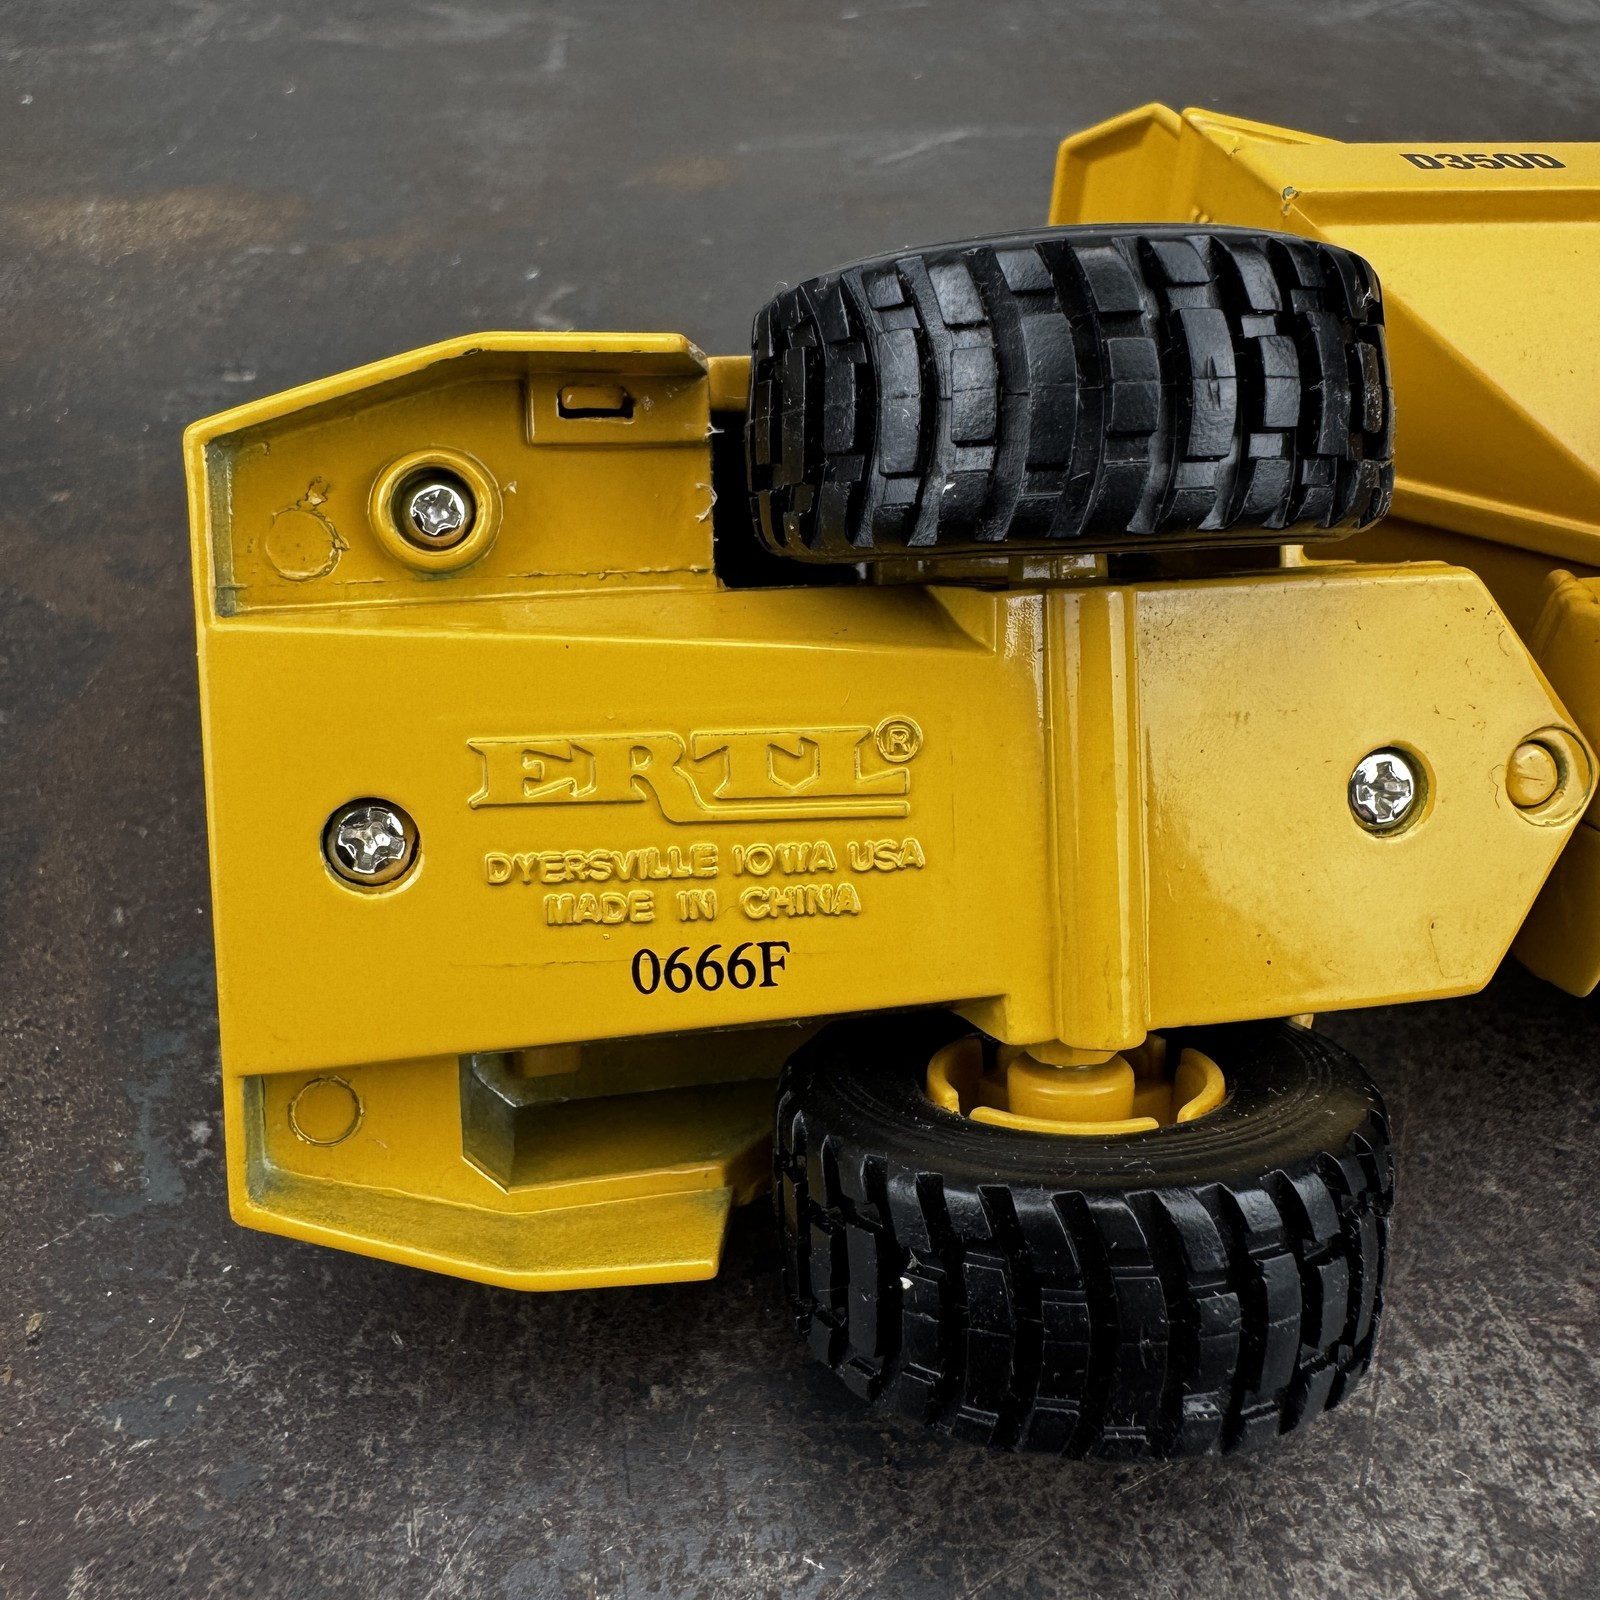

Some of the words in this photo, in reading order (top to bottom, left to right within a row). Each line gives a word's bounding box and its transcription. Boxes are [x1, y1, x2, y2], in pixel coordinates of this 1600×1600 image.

[1400, 153, 1567, 169] D350D
[484, 842, 719, 885] DYERSVILLE
[732, 840, 838, 876] IOWA
[847, 837, 927, 872] USA
[543, 889, 655, 926] MADE
[676, 888, 718, 921] IN
[739, 882, 862, 919] CHINA
[631, 941, 790, 995] 0666F
